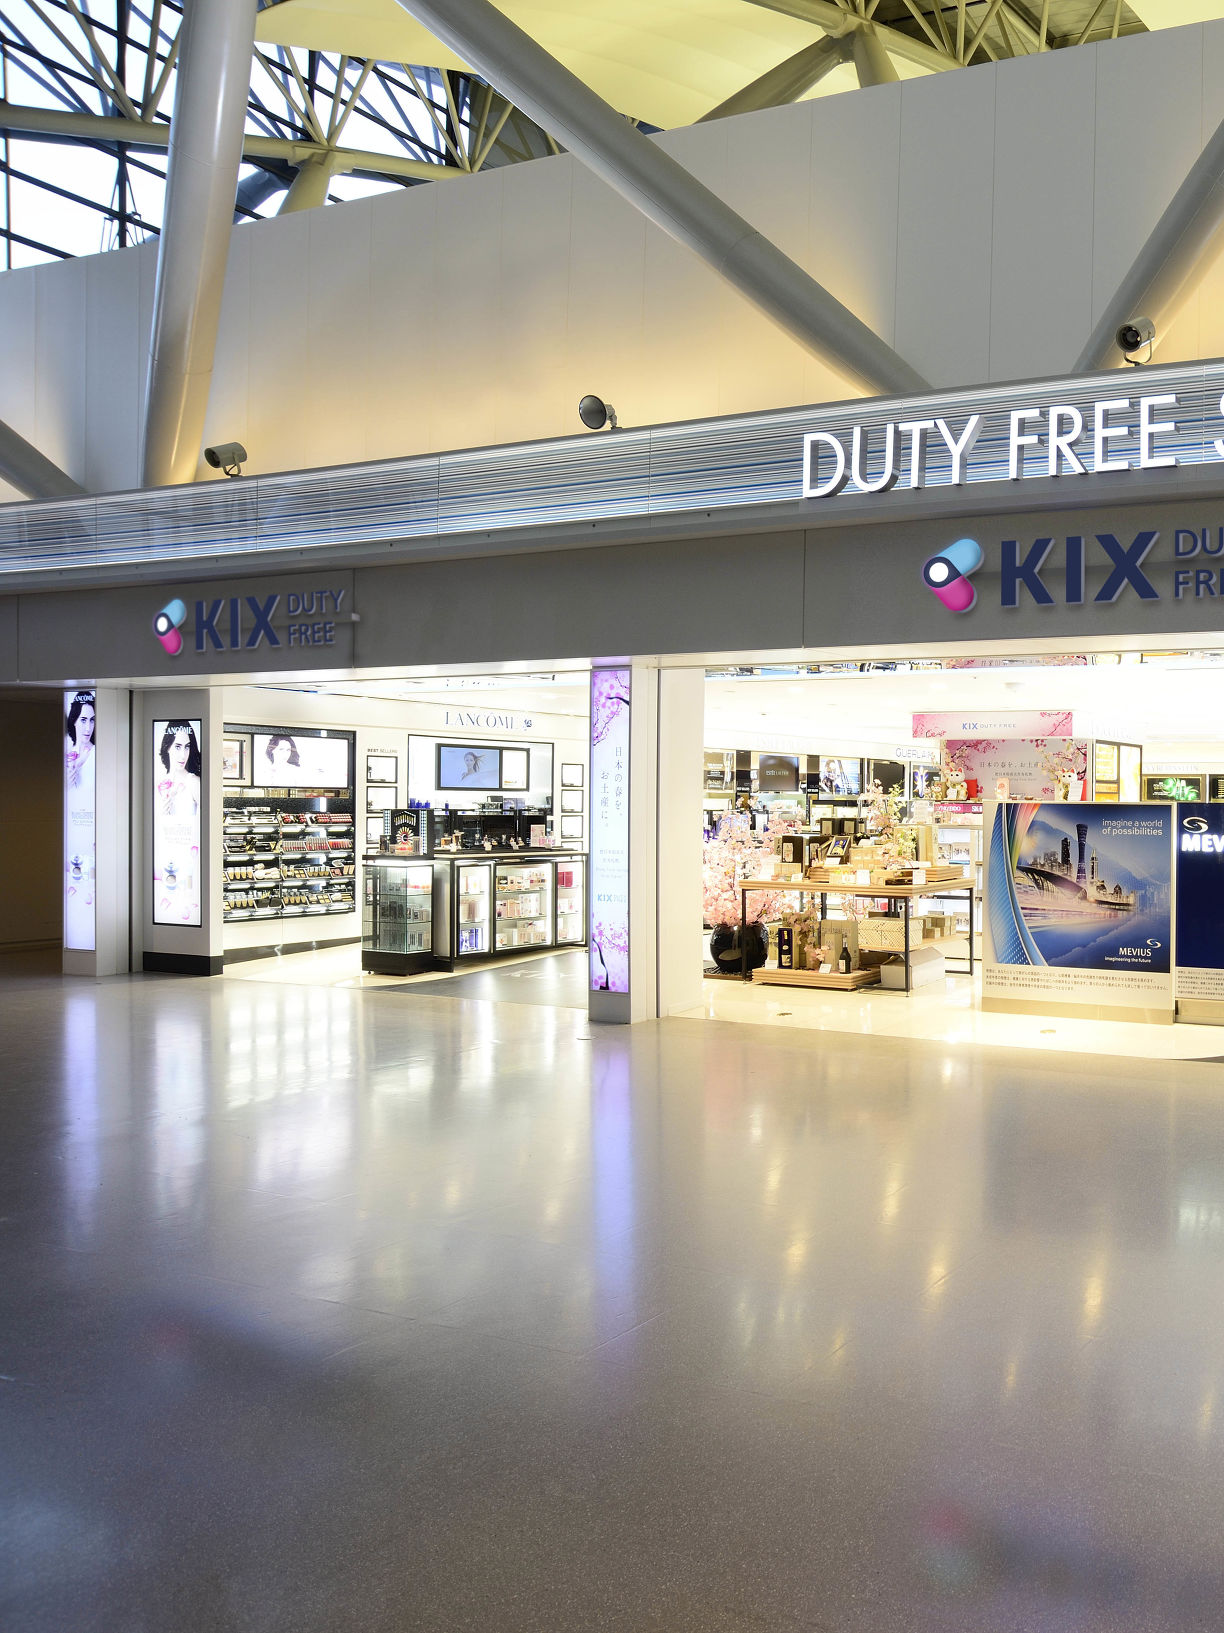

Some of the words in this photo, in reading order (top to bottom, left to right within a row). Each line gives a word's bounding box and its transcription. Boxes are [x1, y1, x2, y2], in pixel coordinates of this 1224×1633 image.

[802, 415, 985, 499] DUTY
[1009, 394, 1181, 479] FREE
[1000, 531, 1161, 607] KIX
[287, 589, 345, 616] DUTY
[195, 594, 281, 652] KIX
[288, 621, 336, 646] FREE
[962, 722, 978, 730] KIX
[1102, 819, 1133, 828] imagine
[1102, 827, 1111, 835] of
[1112, 827, 1163, 836] possibilities
[597, 893, 612, 902] KIX
[1119, 947, 1152, 957] MEVIUS
